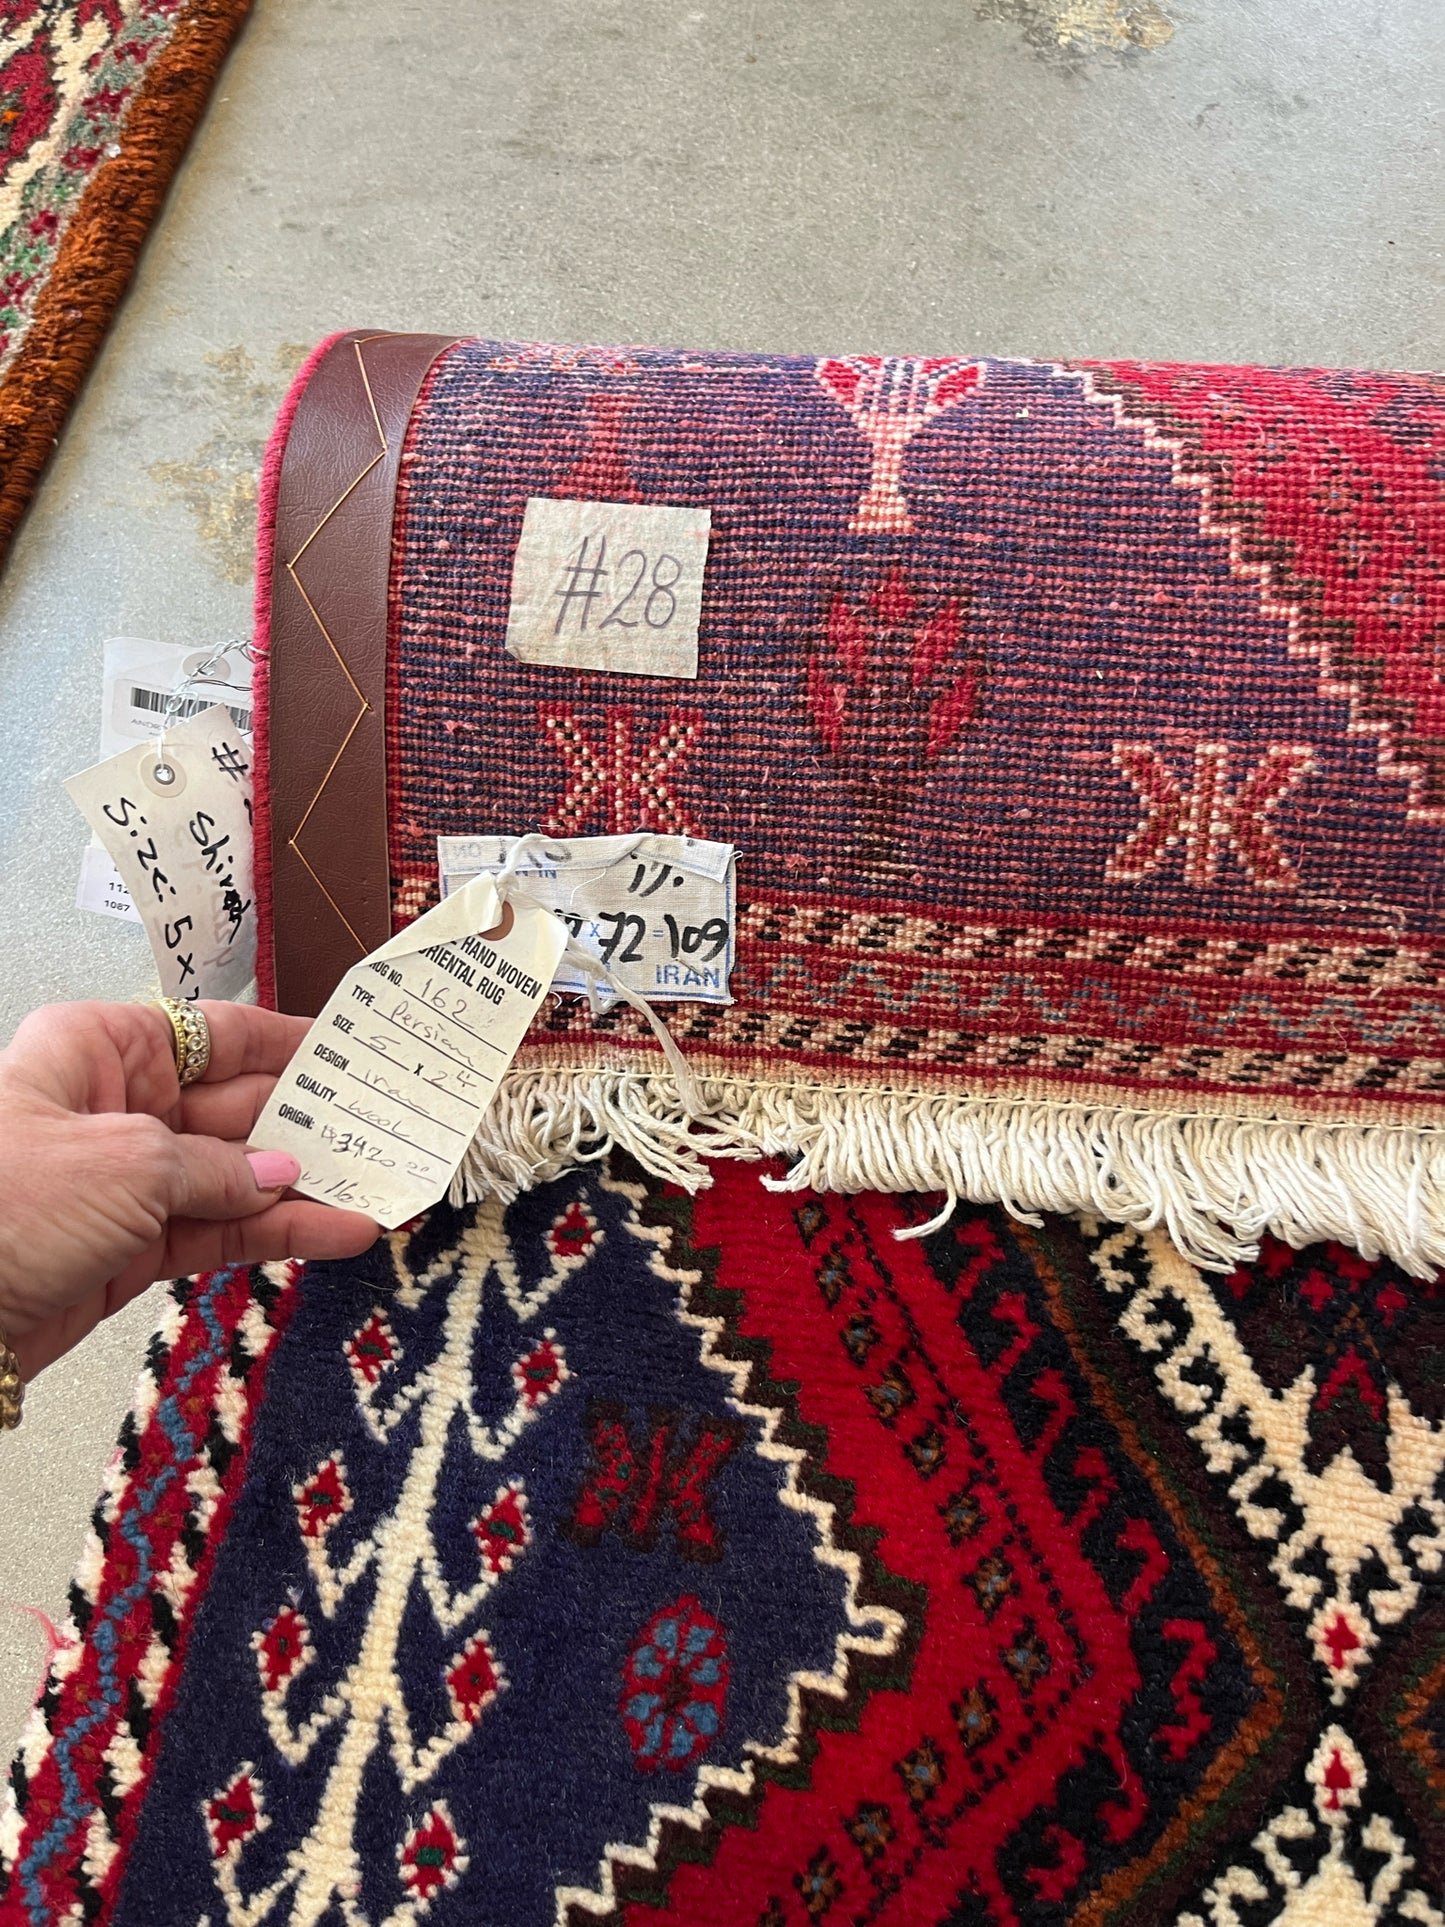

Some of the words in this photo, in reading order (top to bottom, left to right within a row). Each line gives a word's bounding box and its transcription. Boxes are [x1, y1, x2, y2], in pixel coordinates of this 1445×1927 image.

[554, 534, 684, 635] #28
[104, 899, 131, 912] 1087
[165, 915, 193, 949] 5
[598, 911, 646, 964] 72
[664, 913, 730, 963] 109
[387, 969, 404, 987] NO.
[460, 935, 498, 970] HAND
[496, 958, 543, 1000] WOVEN
[656, 964, 720, 989] IRAN
[351, 984, 376, 1008] TYPE
[476, 976, 506, 1006] RUG
[332, 1014, 355, 1035] SIZE
[313, 1043, 350, 1072] DESIGN
[295, 1073, 338, 1102] QUALITY
[278, 1103, 315, 1130] ORIGIN:
